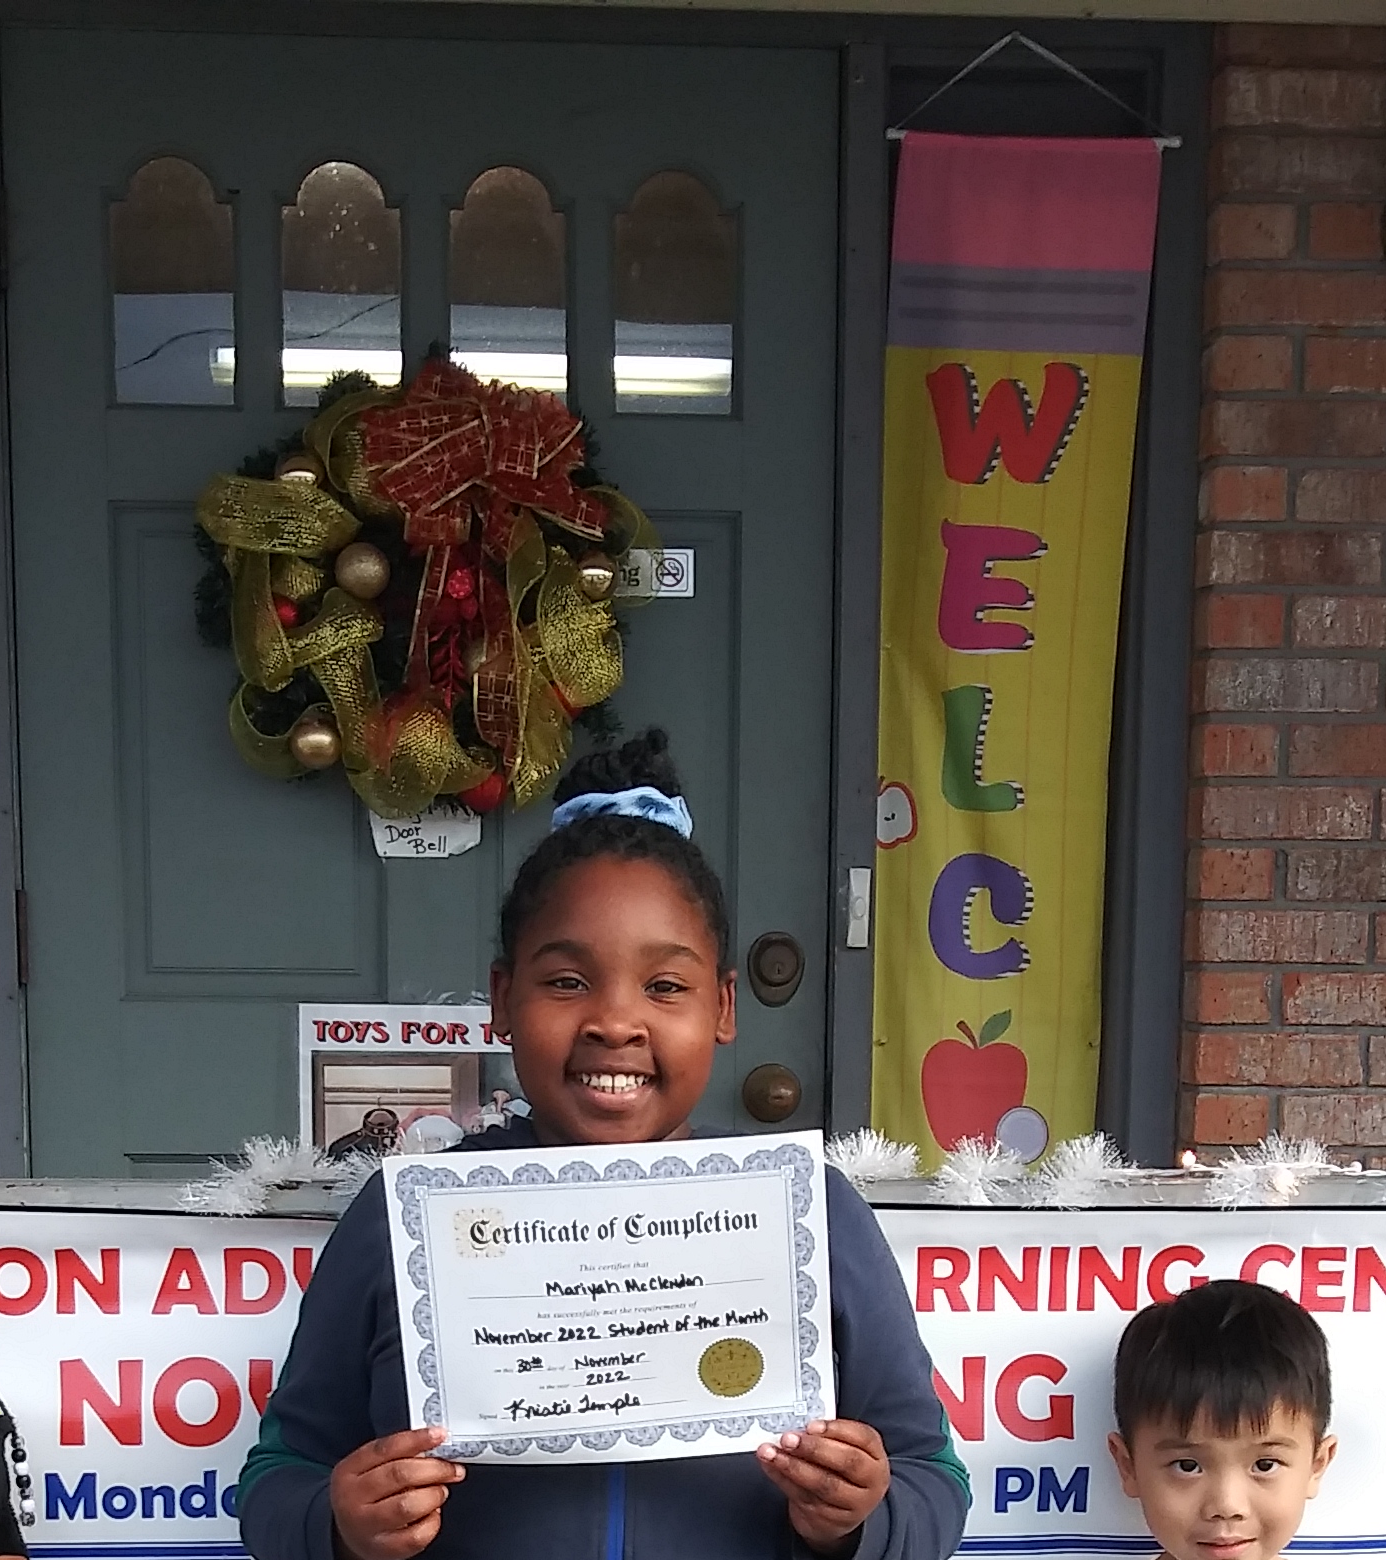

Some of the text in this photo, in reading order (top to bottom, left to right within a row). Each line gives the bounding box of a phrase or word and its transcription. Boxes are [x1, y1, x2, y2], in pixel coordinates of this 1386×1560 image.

[384, 825, 421, 843] Door
[407, 836, 447, 854] Bell
[312, 1020, 389, 1043] TOYS
[401, 1021, 471, 1045] FOR
[469, 1210, 758, 1251] Certificate of Completion
[545, 1280, 621, 1301] Mariyah
[474, 1308, 770, 1346] November 2022 Student of the Month
[574, 1352, 646, 1370] November
[585, 1370, 631, 1386] 2022
[994, 1466, 1091, 1513] PM
